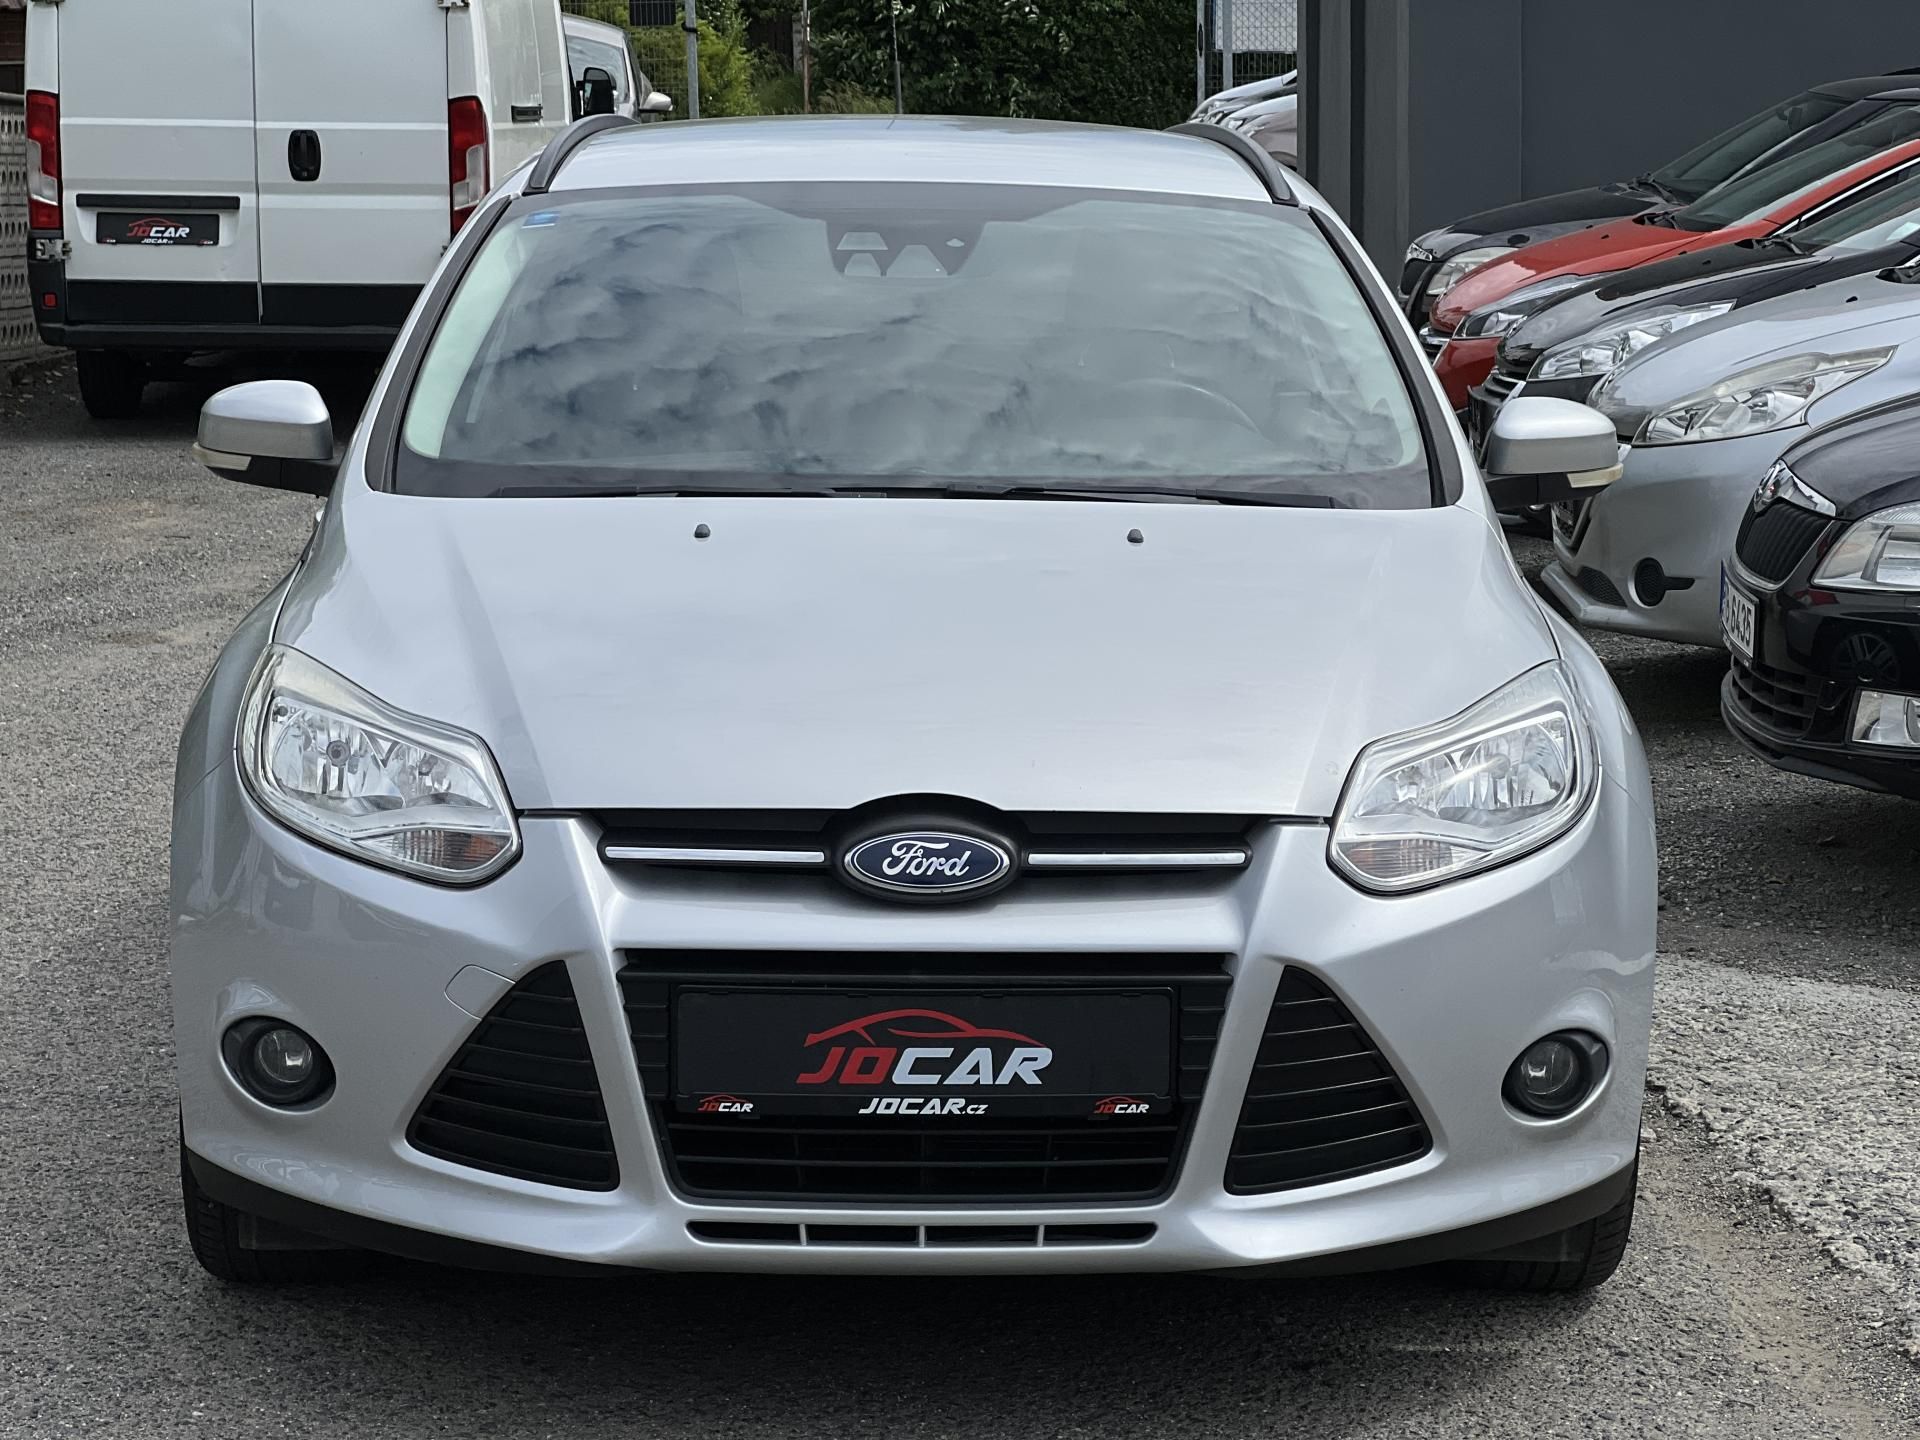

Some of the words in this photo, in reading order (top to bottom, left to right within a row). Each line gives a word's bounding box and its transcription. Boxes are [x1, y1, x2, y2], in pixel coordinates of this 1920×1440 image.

[127, 227, 190, 238] JOCAR
[882, 840, 972, 876] Ford
[797, 1047, 1053, 1085] JOCAR
[697, 1102, 754, 1113] JOCAR
[1093, 1103, 1150, 1114] JOCAR
